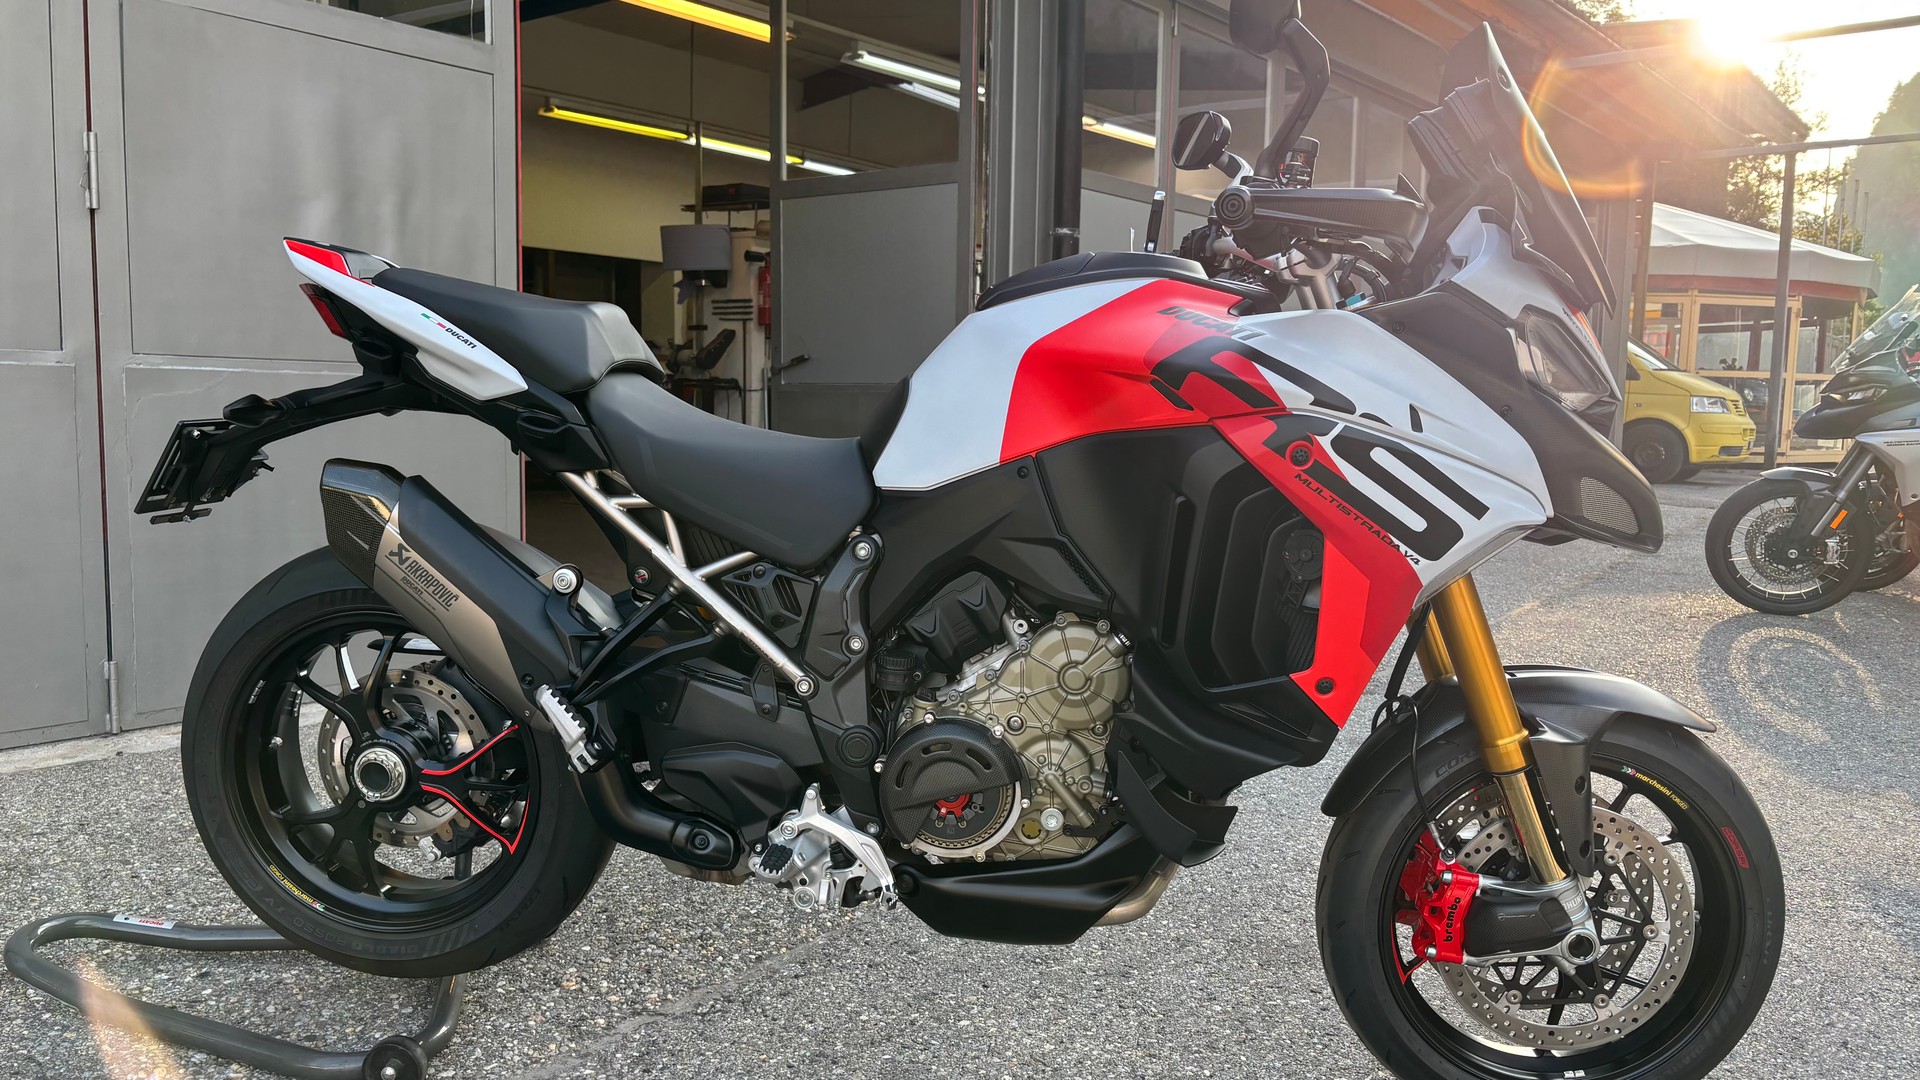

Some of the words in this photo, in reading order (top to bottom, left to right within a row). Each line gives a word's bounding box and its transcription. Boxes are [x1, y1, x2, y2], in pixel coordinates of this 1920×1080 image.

[1156, 305, 1267, 341] DUCATI
[445, 327, 477, 349] DUCATI
[1294, 473, 1400, 553] MULTISTRADA
[1403, 550, 1420, 566] V4
[401, 575, 424, 595] DUCATI
[1635, 772, 1673, 796] marchesini
[1723, 828, 1747, 865] CORSA
[281, 879, 314, 903] marchesini
[292, 917, 345, 945] ROSSO
[1443, 896, 1461, 942] brembo
[352, 943, 419, 955] DIABLO
